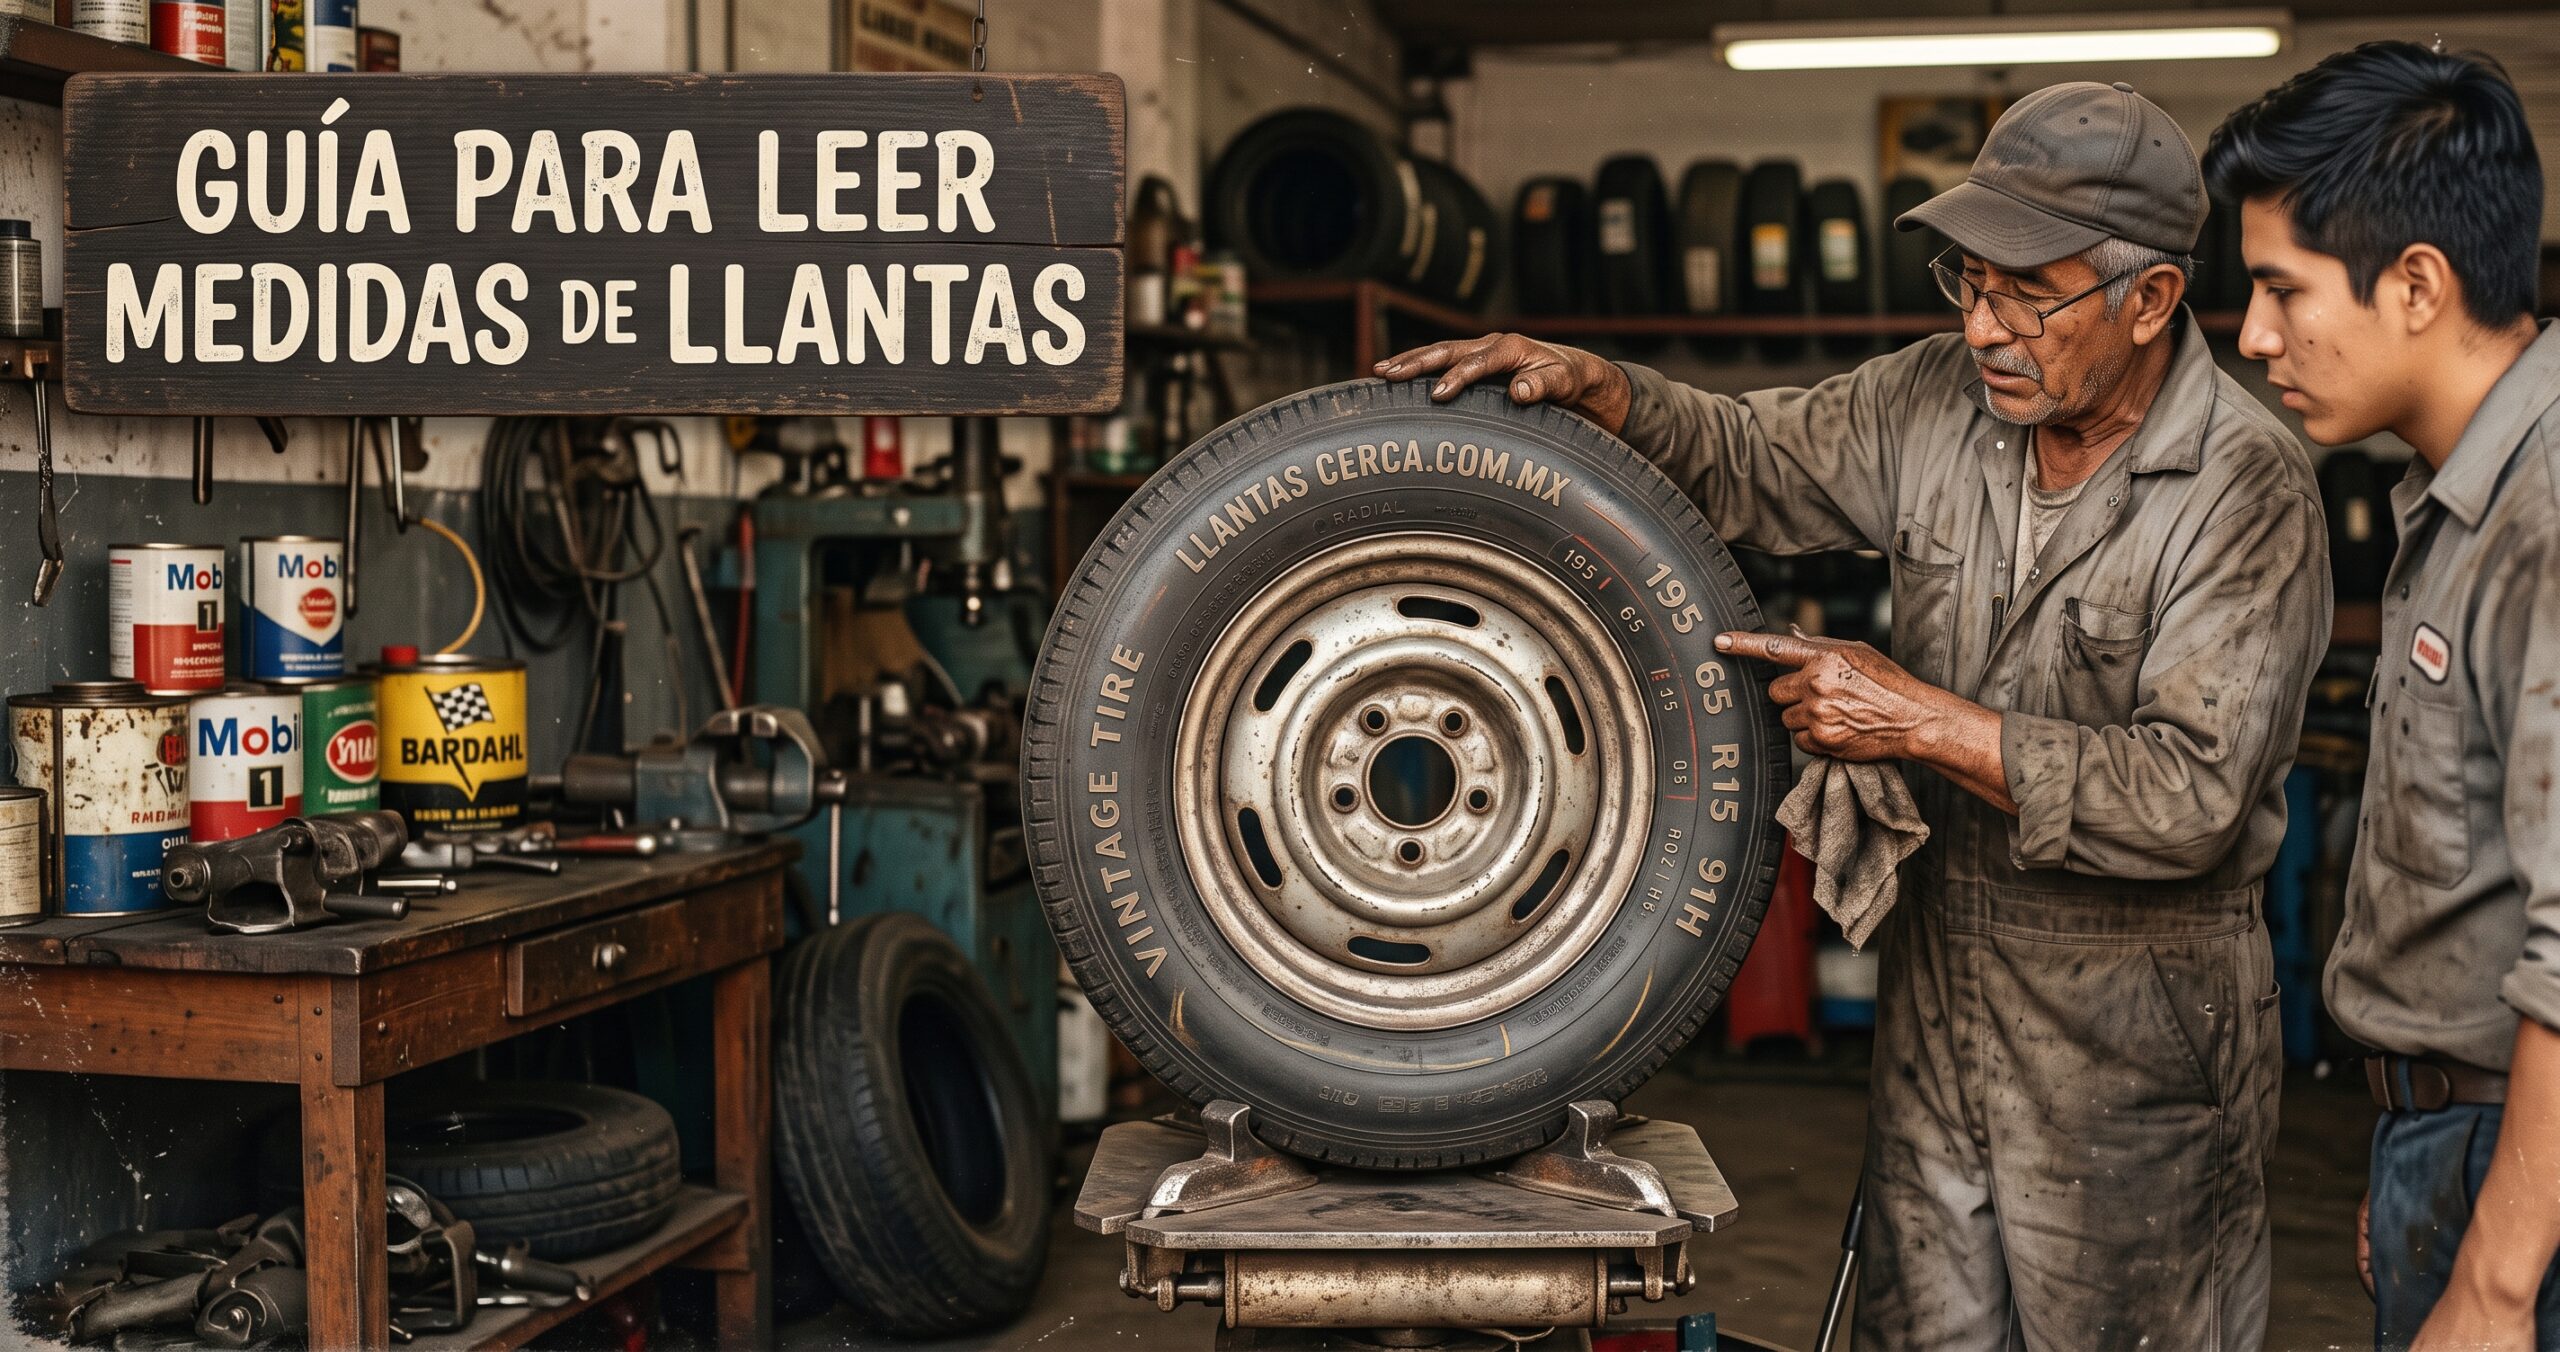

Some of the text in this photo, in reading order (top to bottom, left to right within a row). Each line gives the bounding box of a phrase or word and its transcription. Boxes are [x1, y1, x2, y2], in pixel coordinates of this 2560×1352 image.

[177, 97, 996, 234] GUÍA PARA LEER
[106, 262, 529, 366] MEDIDAS
[560, 279, 637, 344] DE
[669, 263, 1086, 366] LLANTAS
[1175, 465, 1309, 574] LLANTAS
[1315, 439, 1572, 507] CERCA.COM.MX
[1333, 500, 1406, 526] RADIAL
[203, 603, 212, 631] 1
[1562, 548, 1599, 581] 195
[1620, 605, 1645, 633] 65
[259, 770, 273, 805] 1
[401, 733, 524, 780] BARDAHL
[1645, 562, 1740, 938] 195 65 R15 91H
[1088, 643, 1168, 978] VINTAGE TIRE
